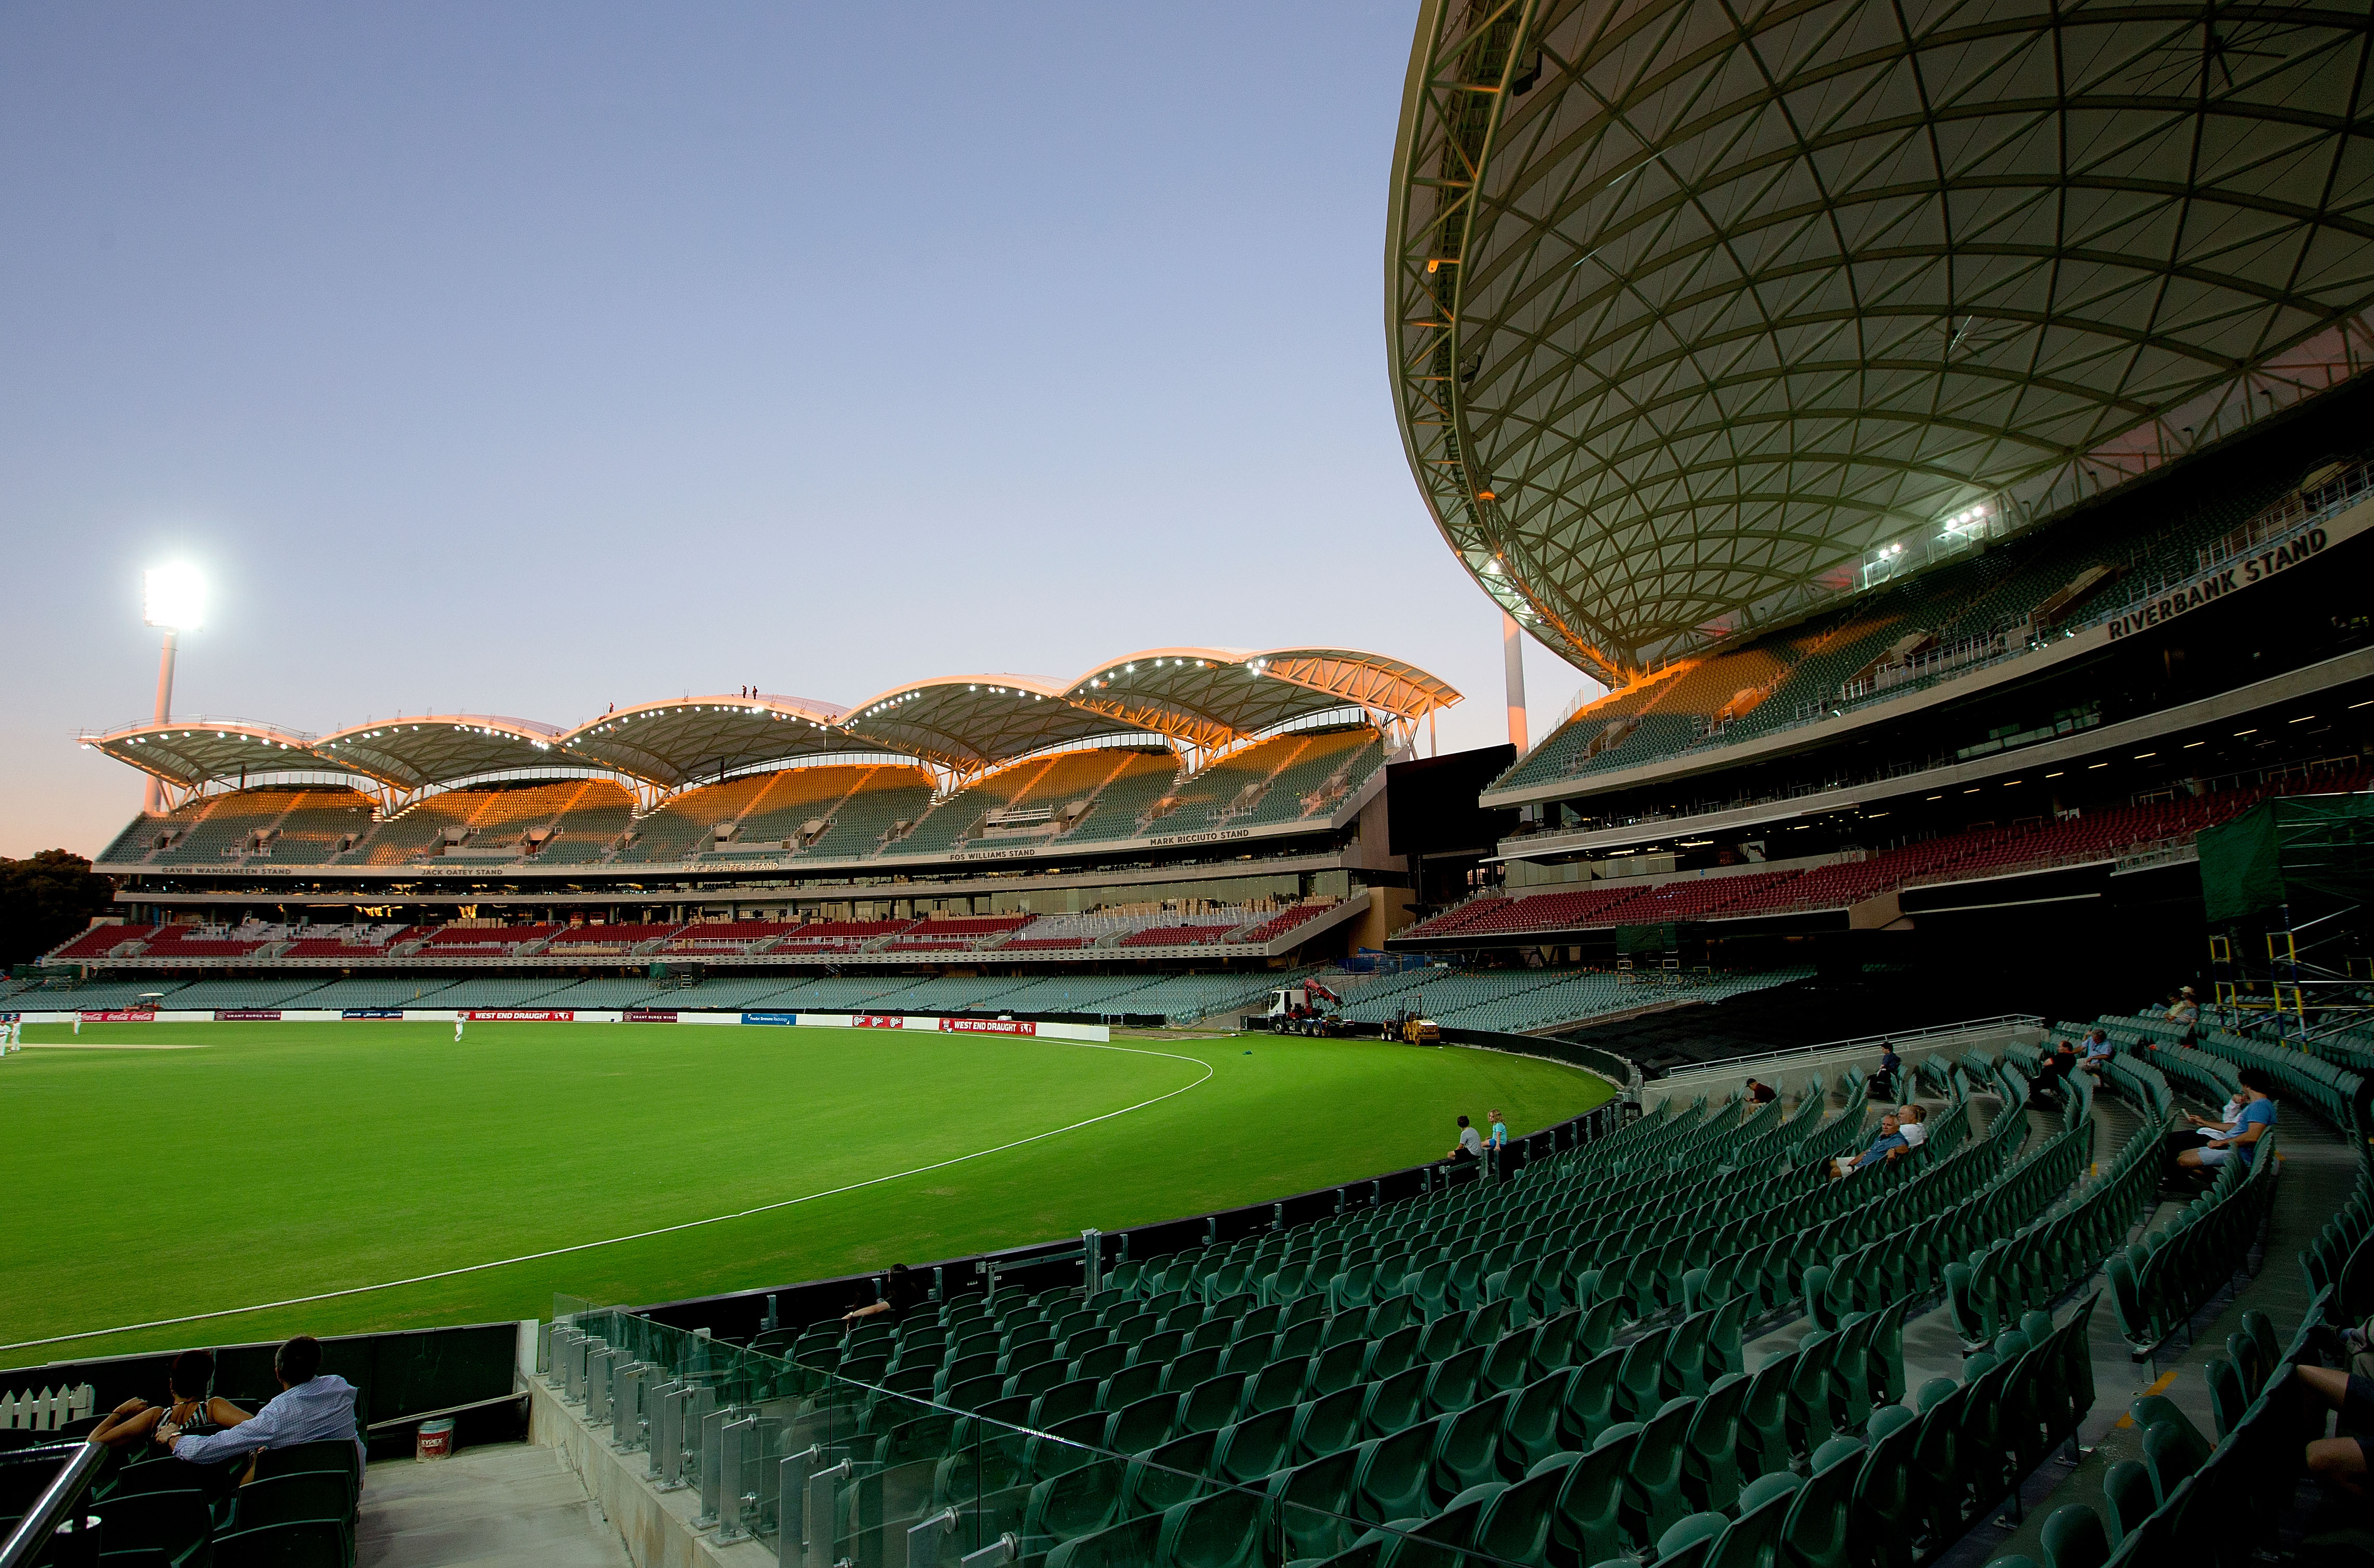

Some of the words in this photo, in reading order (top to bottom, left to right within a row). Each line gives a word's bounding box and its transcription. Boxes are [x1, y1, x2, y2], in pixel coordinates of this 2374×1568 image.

[2107, 568, 2238, 640] RIVERBANK
[2244, 528, 2327, 582] STAND
[1150, 837, 1174, 846] MARK
[1178, 832, 1217, 843] RICCIUTO
[1220, 829, 1249, 839] STAND
[968, 851, 1006, 859] WILLIAMS
[705, 864, 746, 872] BASHEER
[954, 1021, 973, 1029] WEST
[987, 1022, 1016, 1032] DRAUGHT
